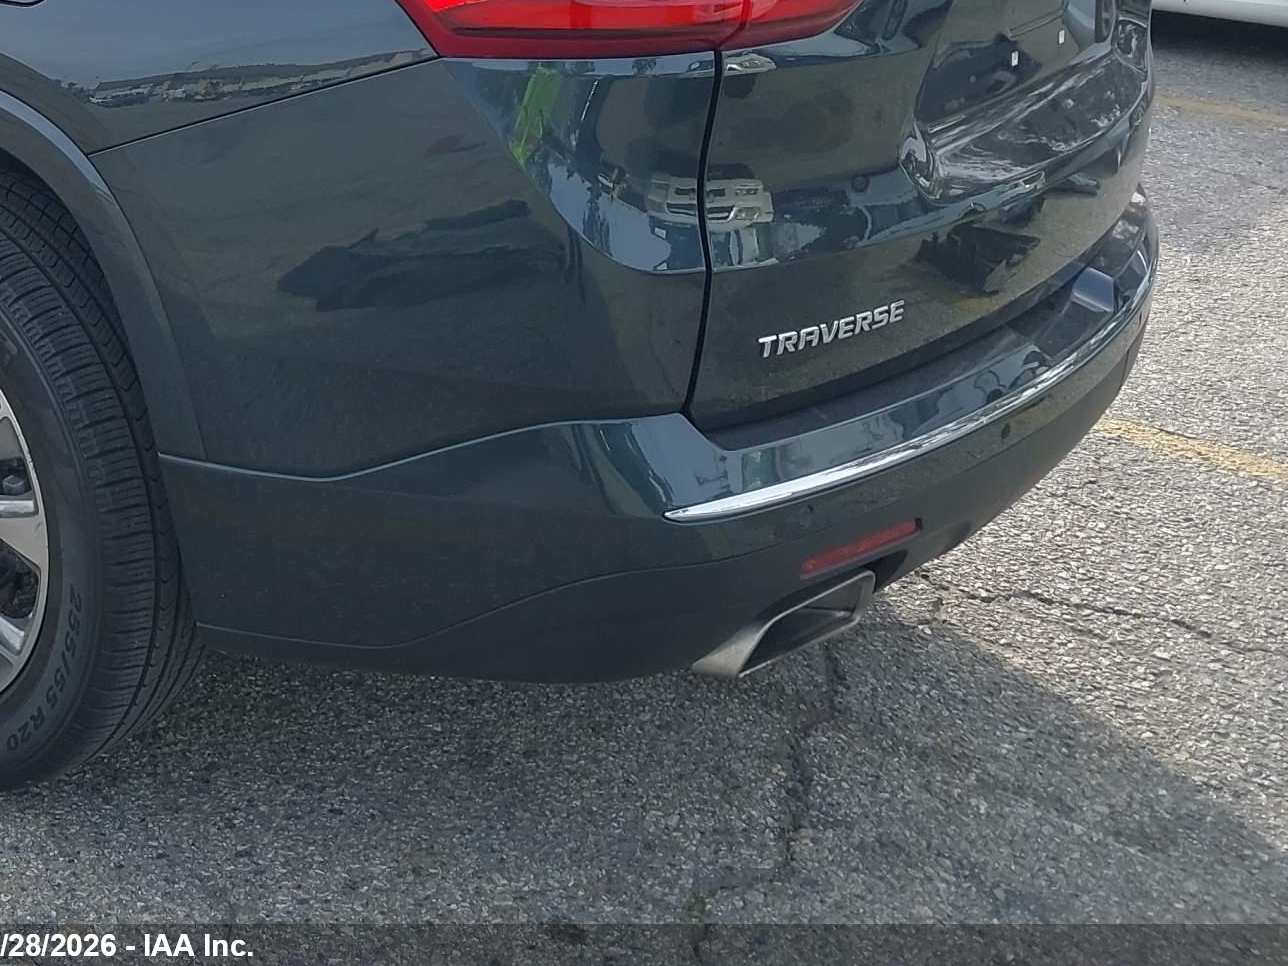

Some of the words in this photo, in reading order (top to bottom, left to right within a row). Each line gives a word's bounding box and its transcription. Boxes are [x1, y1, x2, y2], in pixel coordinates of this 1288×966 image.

[758, 299, 905, 358] TRAVERSE
[45, 583, 83, 710] 255/55
[6, 705, 46, 751] R20
